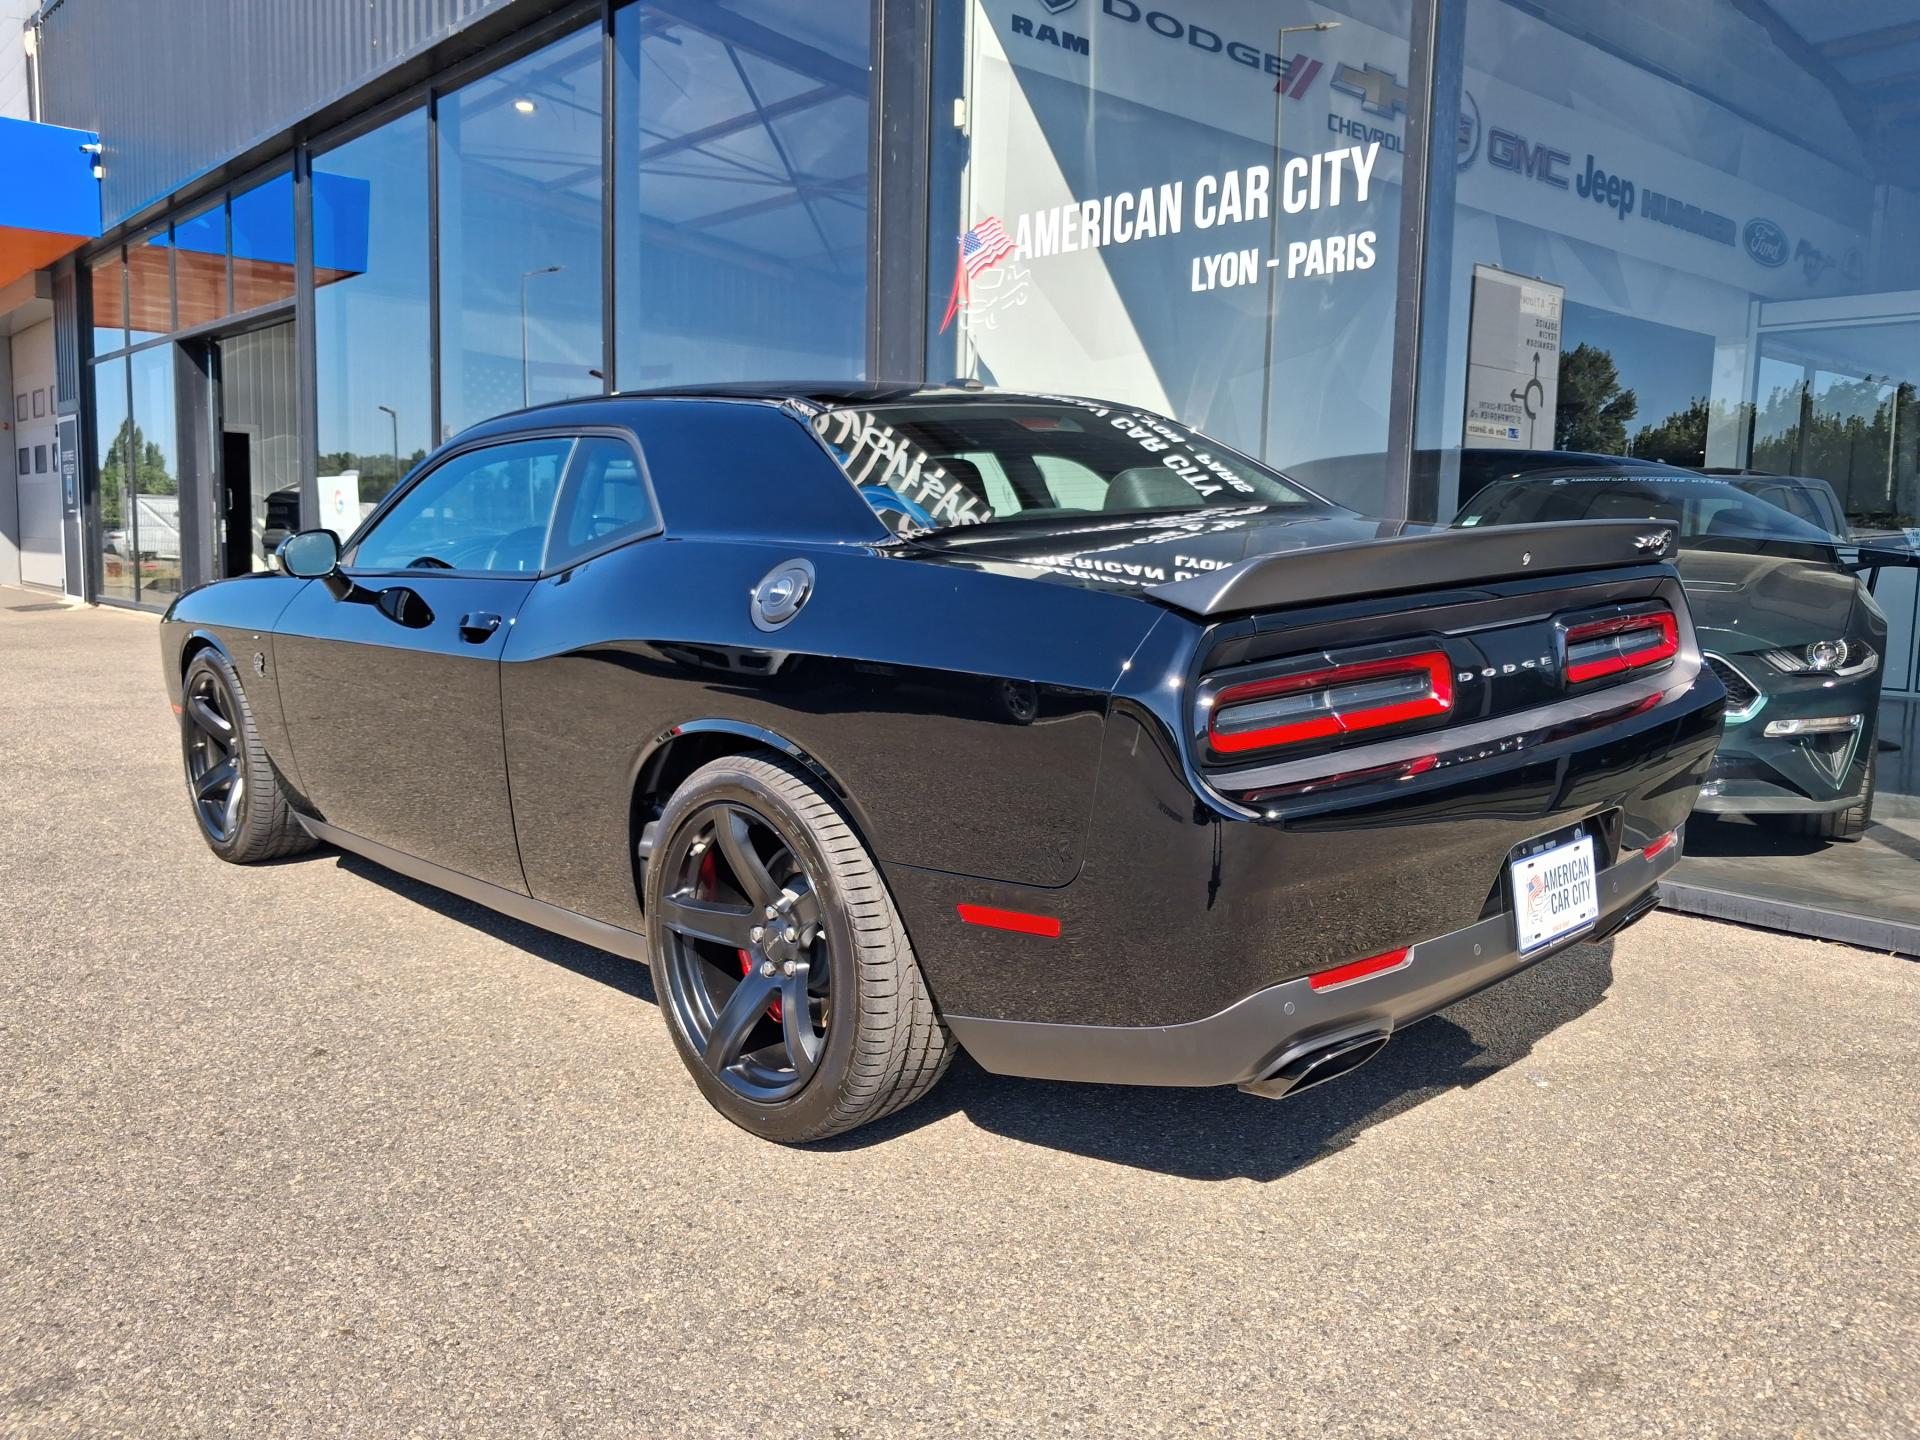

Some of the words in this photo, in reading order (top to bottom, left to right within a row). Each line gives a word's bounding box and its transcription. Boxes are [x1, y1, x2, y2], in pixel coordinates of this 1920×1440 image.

[1011, 14, 1090, 57] RAM
[1102, 0, 1292, 77] DODGE
[1488, 126, 1571, 190] GMC
[1013, 181, 1183, 262] AMERICAN
[1194, 165, 1270, 231] CAR
[1283, 142, 1381, 214] CITY
[1576, 154, 1635, 220] Jeep
[1191, 248, 1259, 292] LYON
[1287, 231, 1377, 279] PARIS
[1751, 223, 1783, 260] Ford
[1457, 656, 1553, 682] DODGE
[1543, 855, 1590, 893] AMERICAN
[1550, 888, 1570, 915] CAR
[1572, 878, 1591, 906] CITY
